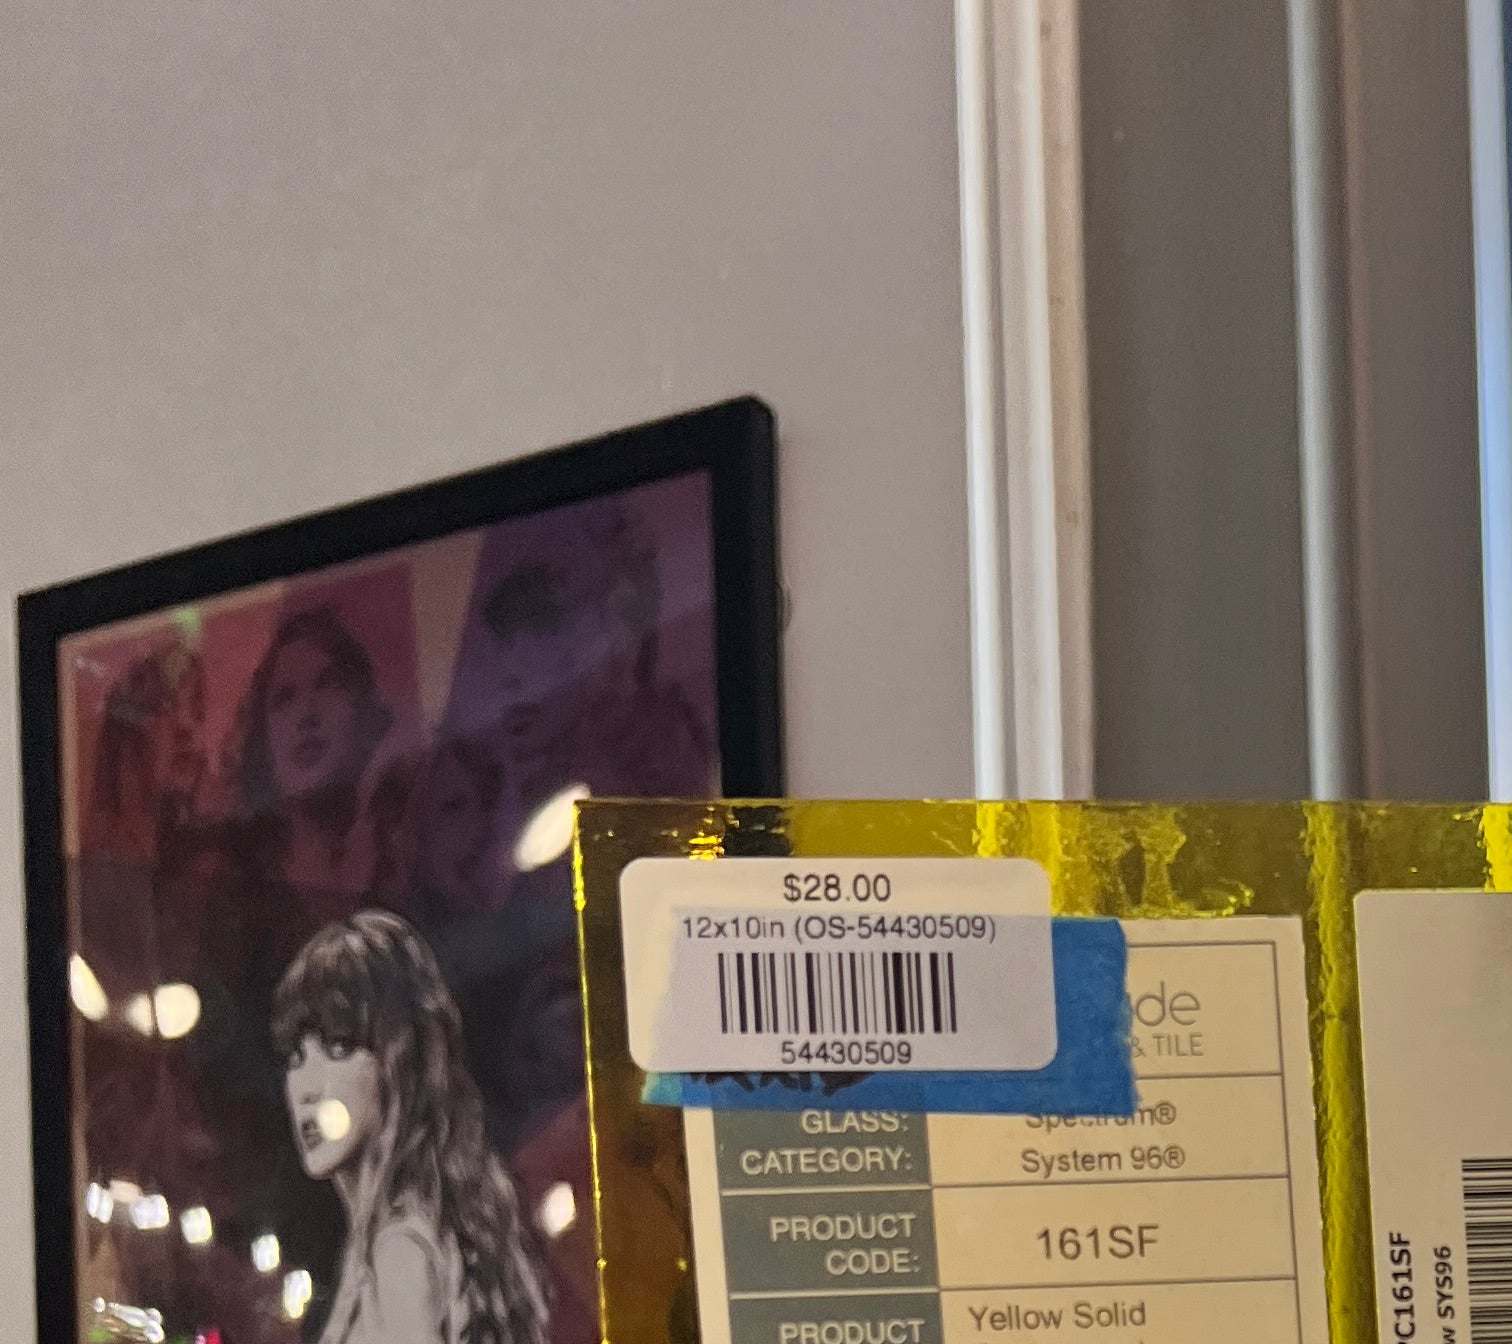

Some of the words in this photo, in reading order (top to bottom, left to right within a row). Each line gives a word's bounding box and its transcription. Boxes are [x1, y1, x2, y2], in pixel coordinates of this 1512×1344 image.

[783, 873, 892, 903] $28.00
[682, 915, 785, 939] 12x10in
[795, 915, 997, 945] (OS-54430509)
[780, 1041, 913, 1065] 54430509
[1152, 1031, 1204, 1057] TILE
[801, 1108, 910, 1135] GLASS:
[741, 1146, 913, 1175] CATEGORY:
[1021, 1148, 1122, 1179] System
[1130, 1145, 1186, 1171] 96®
[769, 1213, 918, 1242] PRODUCT
[1036, 1223, 1160, 1261] 161SF
[825, 1249, 921, 1276] CODE:
[1433, 1245, 1458, 1321] SYS96
[968, 1304, 1063, 1333] Yellow
[1072, 1301, 1148, 1330] Solid
